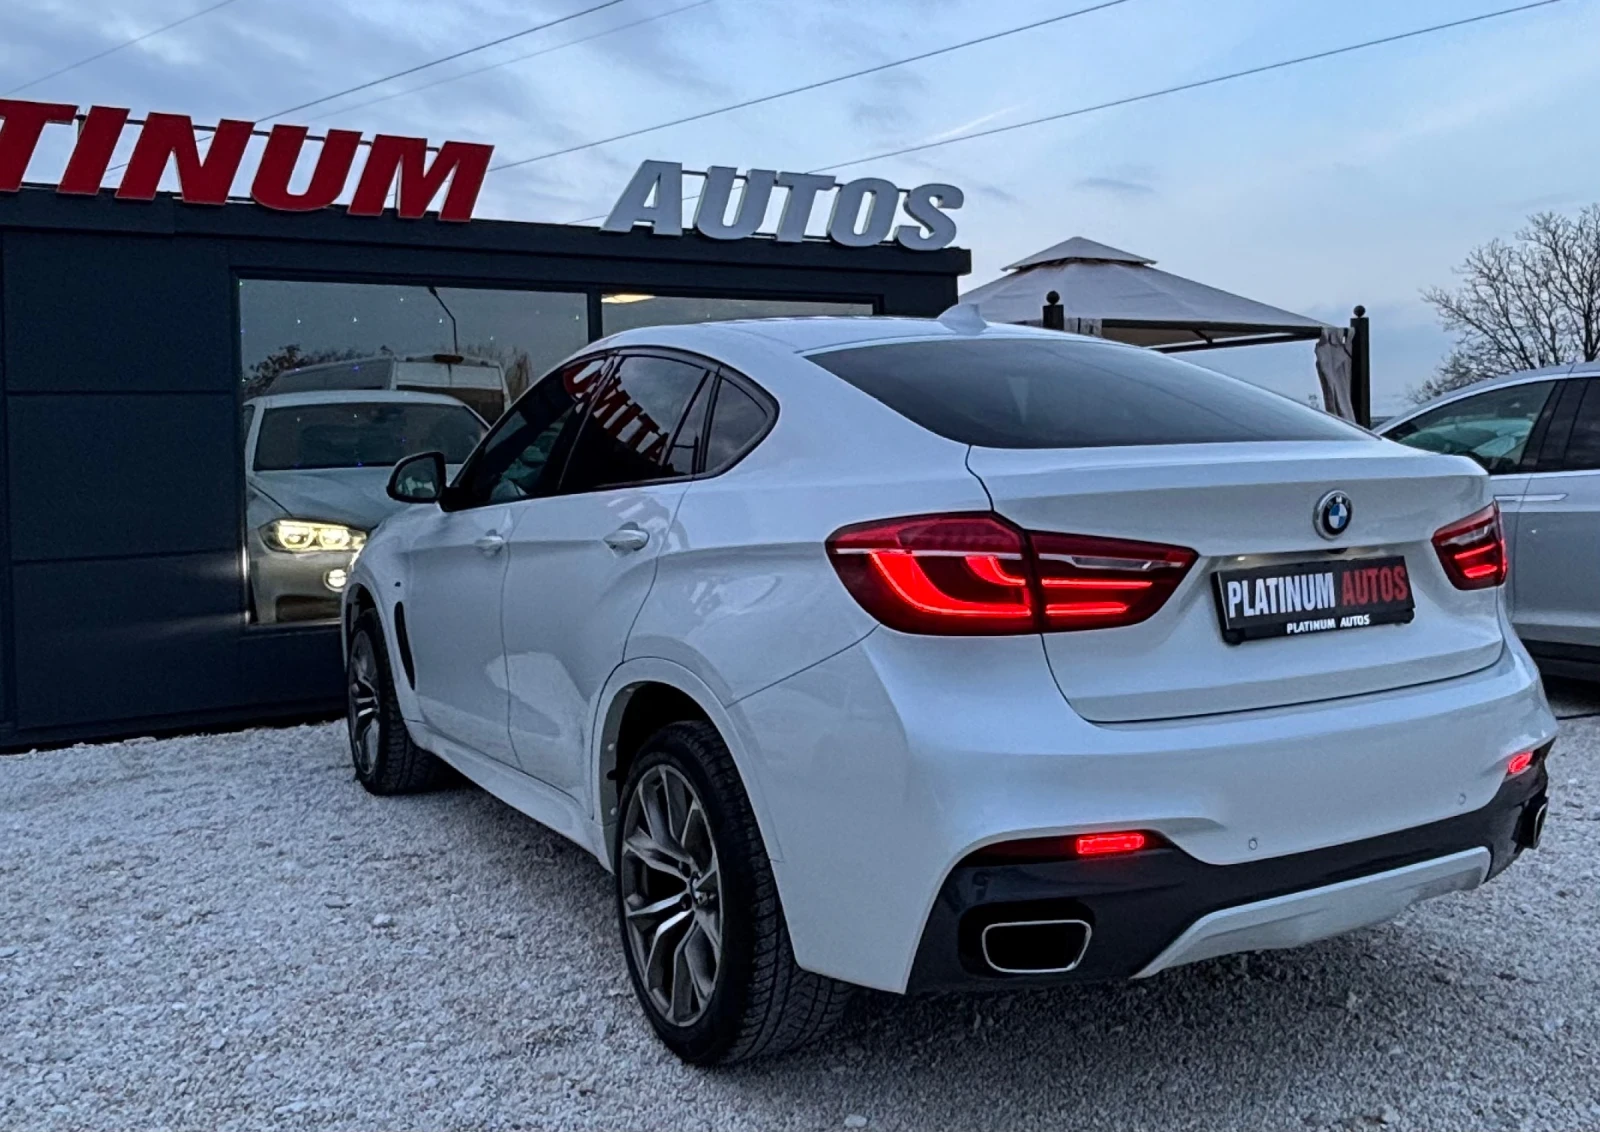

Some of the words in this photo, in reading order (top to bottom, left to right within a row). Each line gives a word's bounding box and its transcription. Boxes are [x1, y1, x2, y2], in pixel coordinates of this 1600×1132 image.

[0, 99, 494, 222] TINUM
[601, 159, 964, 250] AUTOS
[1227, 572, 1336, 618] PLATINUM
[1342, 565, 1408, 606] AUTOS
[1286, 618, 1337, 634] PLATINUM
[1340, 614, 1371, 628] AUTOS
